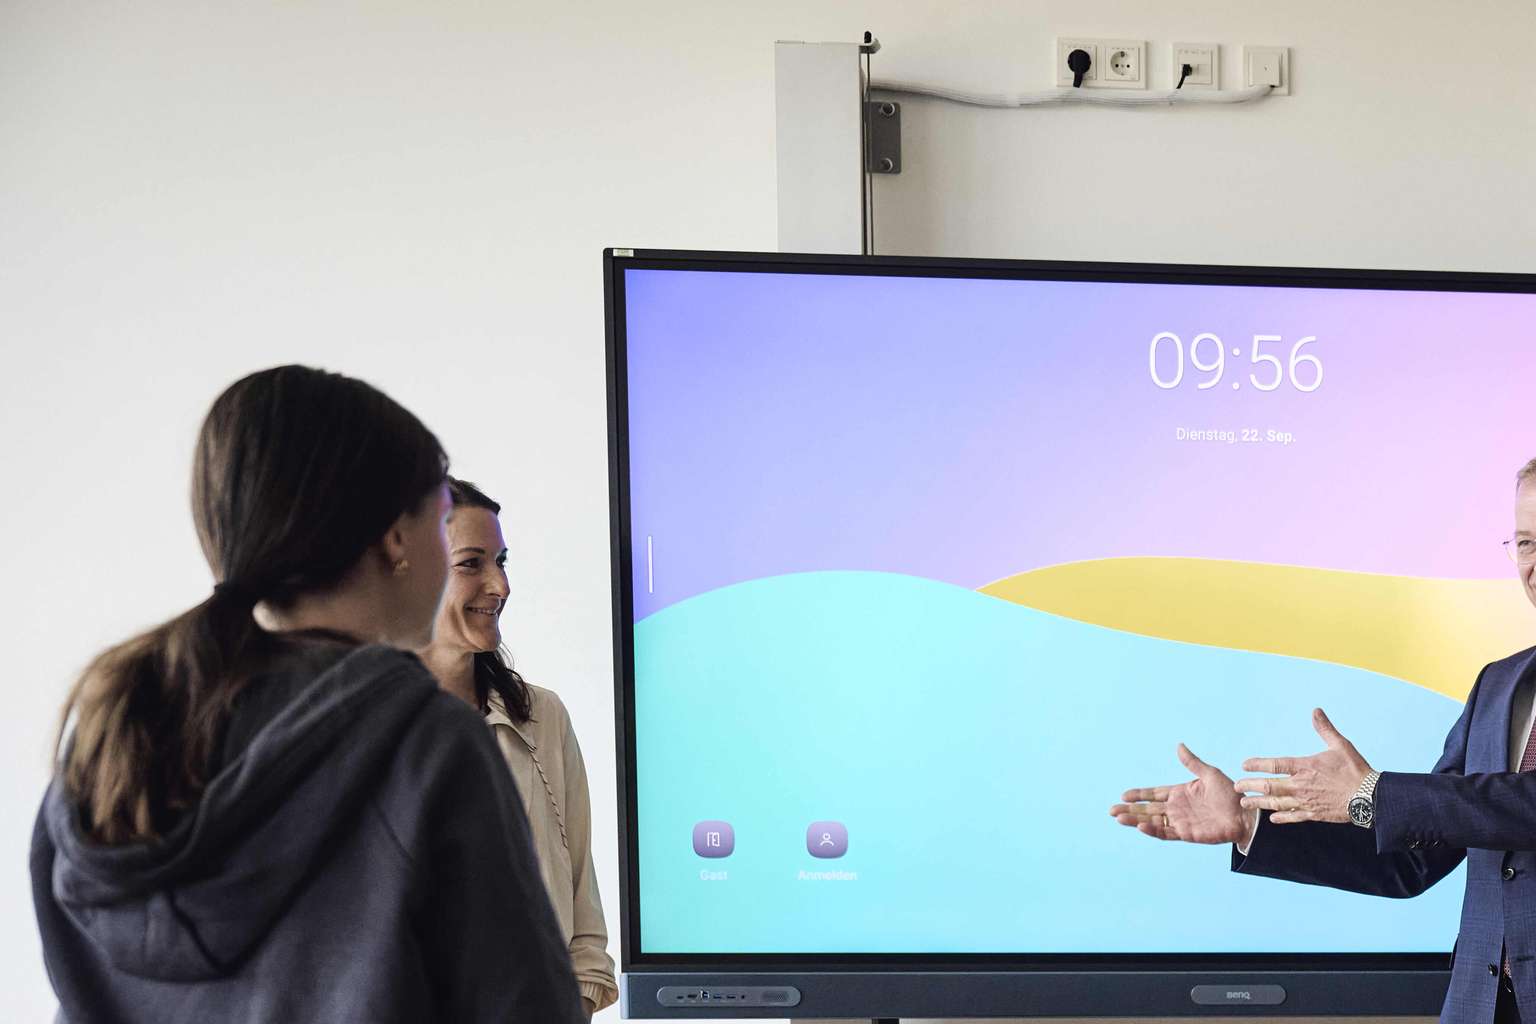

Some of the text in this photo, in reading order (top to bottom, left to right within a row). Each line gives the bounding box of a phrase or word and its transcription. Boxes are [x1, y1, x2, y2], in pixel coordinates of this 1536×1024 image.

[1149, 331, 1324, 393] 09:56
[1175, 426, 1297, 446] Dienstag, 22. Sep.
[699, 869, 858, 881] Gast Anmelden
[1226, 991, 1251, 1001] BenQ
